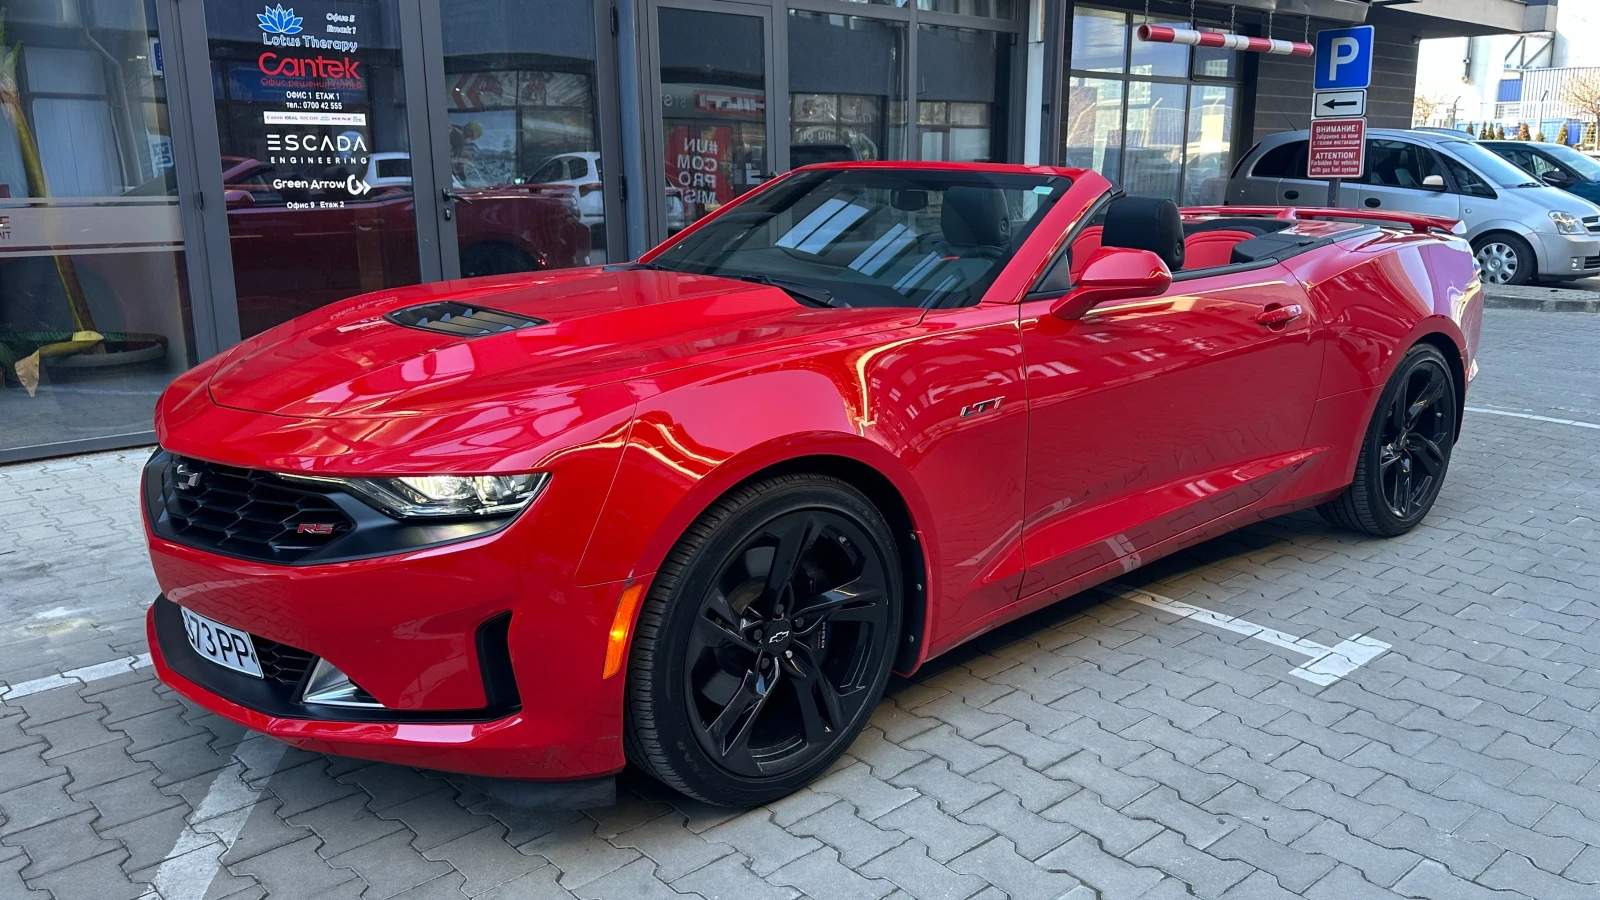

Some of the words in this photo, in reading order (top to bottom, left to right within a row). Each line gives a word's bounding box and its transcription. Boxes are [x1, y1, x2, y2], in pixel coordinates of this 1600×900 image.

[262, 32, 301, 47] Lotus
[302, 34, 358, 52] Therapy
[1328, 36, 1360, 81] P
[258, 51, 361, 79] Cantek
[260, 78, 286, 88] Офис
[288, 79, 330, 89] решения
[286, 91, 307, 99] ОФИС
[315, 92, 335, 100] ЕТАЖ
[286, 101, 302, 109] тел.:
[303, 101, 320, 109] 0700
[330, 102, 343, 110] 555
[1316, 124, 1359, 133] ВНИМАНИЕ!
[266, 133, 368, 152] ESCADA
[270, 156, 368, 165] ENGINEERING
[1315, 152, 1357, 160] ATTENTION!
[272, 179, 309, 190] Green
[310, 179, 346, 190] Arrow
[286, 201, 309, 211] Офис
[310, 201, 316, 209] 9
[319, 201, 340, 209] Етаж
[297, 523, 335, 534] RS
